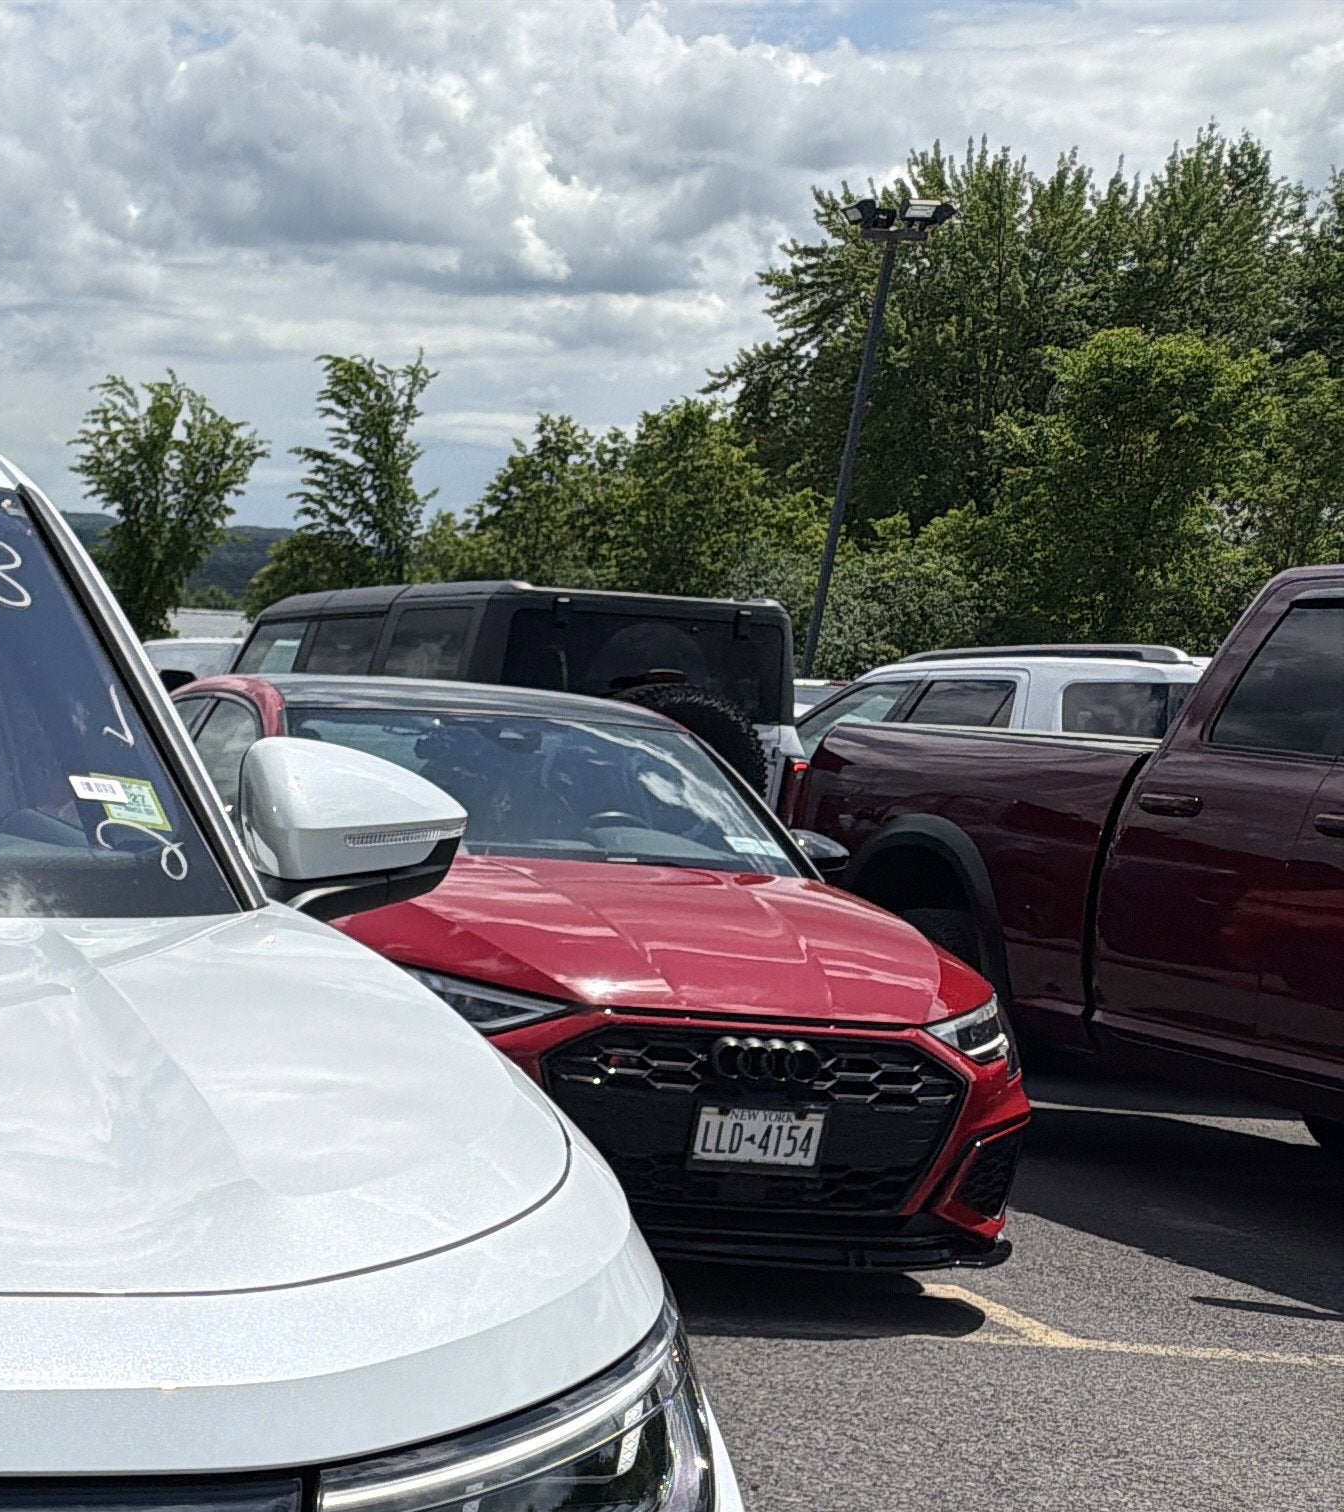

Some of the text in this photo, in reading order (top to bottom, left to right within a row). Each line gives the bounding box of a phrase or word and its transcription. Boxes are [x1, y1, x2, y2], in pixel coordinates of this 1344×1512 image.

[729, 1109, 795, 1123] NEW YORK
[700, 1120, 815, 1158] LLD 4154
